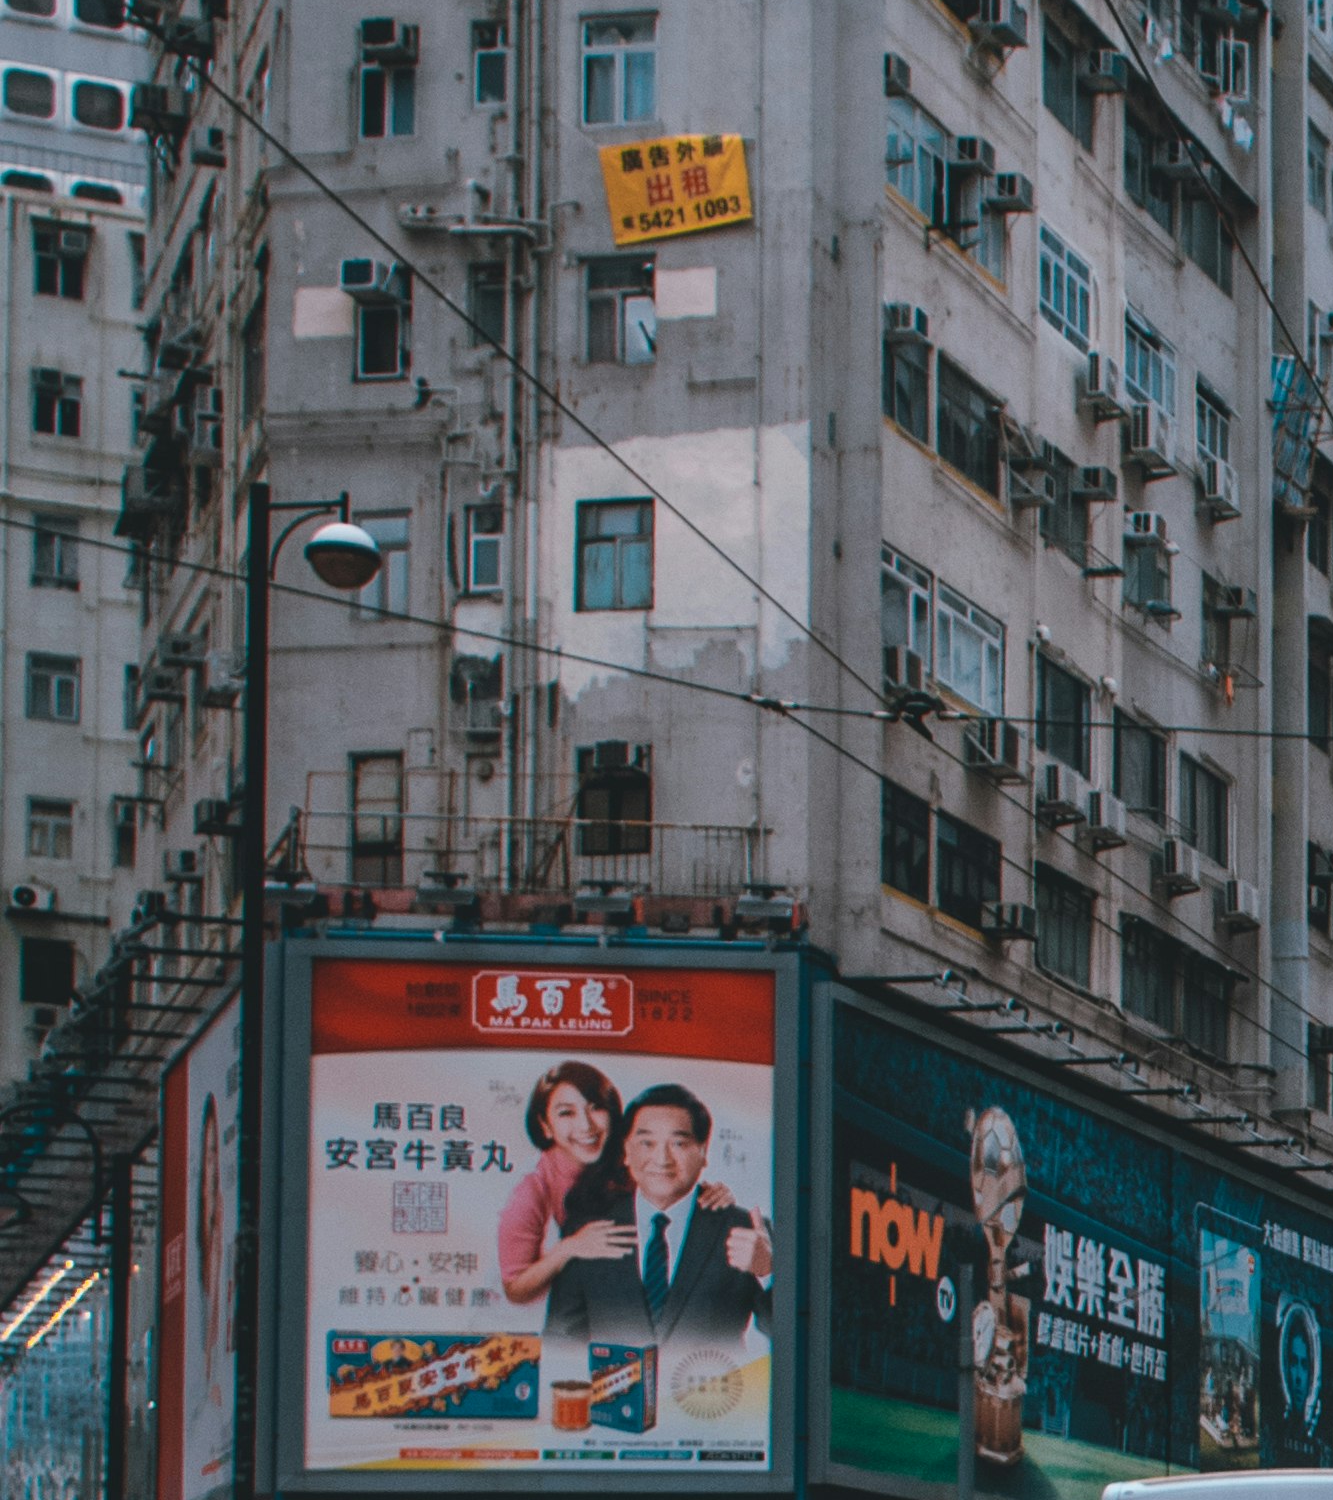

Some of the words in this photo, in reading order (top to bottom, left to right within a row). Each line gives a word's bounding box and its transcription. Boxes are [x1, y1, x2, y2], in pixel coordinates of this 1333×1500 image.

[491, 975, 613, 1016] 馬百良
[489, 1016, 515, 1028] MA
[521, 1016, 553, 1028] PAK
[559, 1016, 613, 1030] LEUNG
[374, 1102, 468, 1132] 馬百良
[850, 1187, 944, 1280] now
